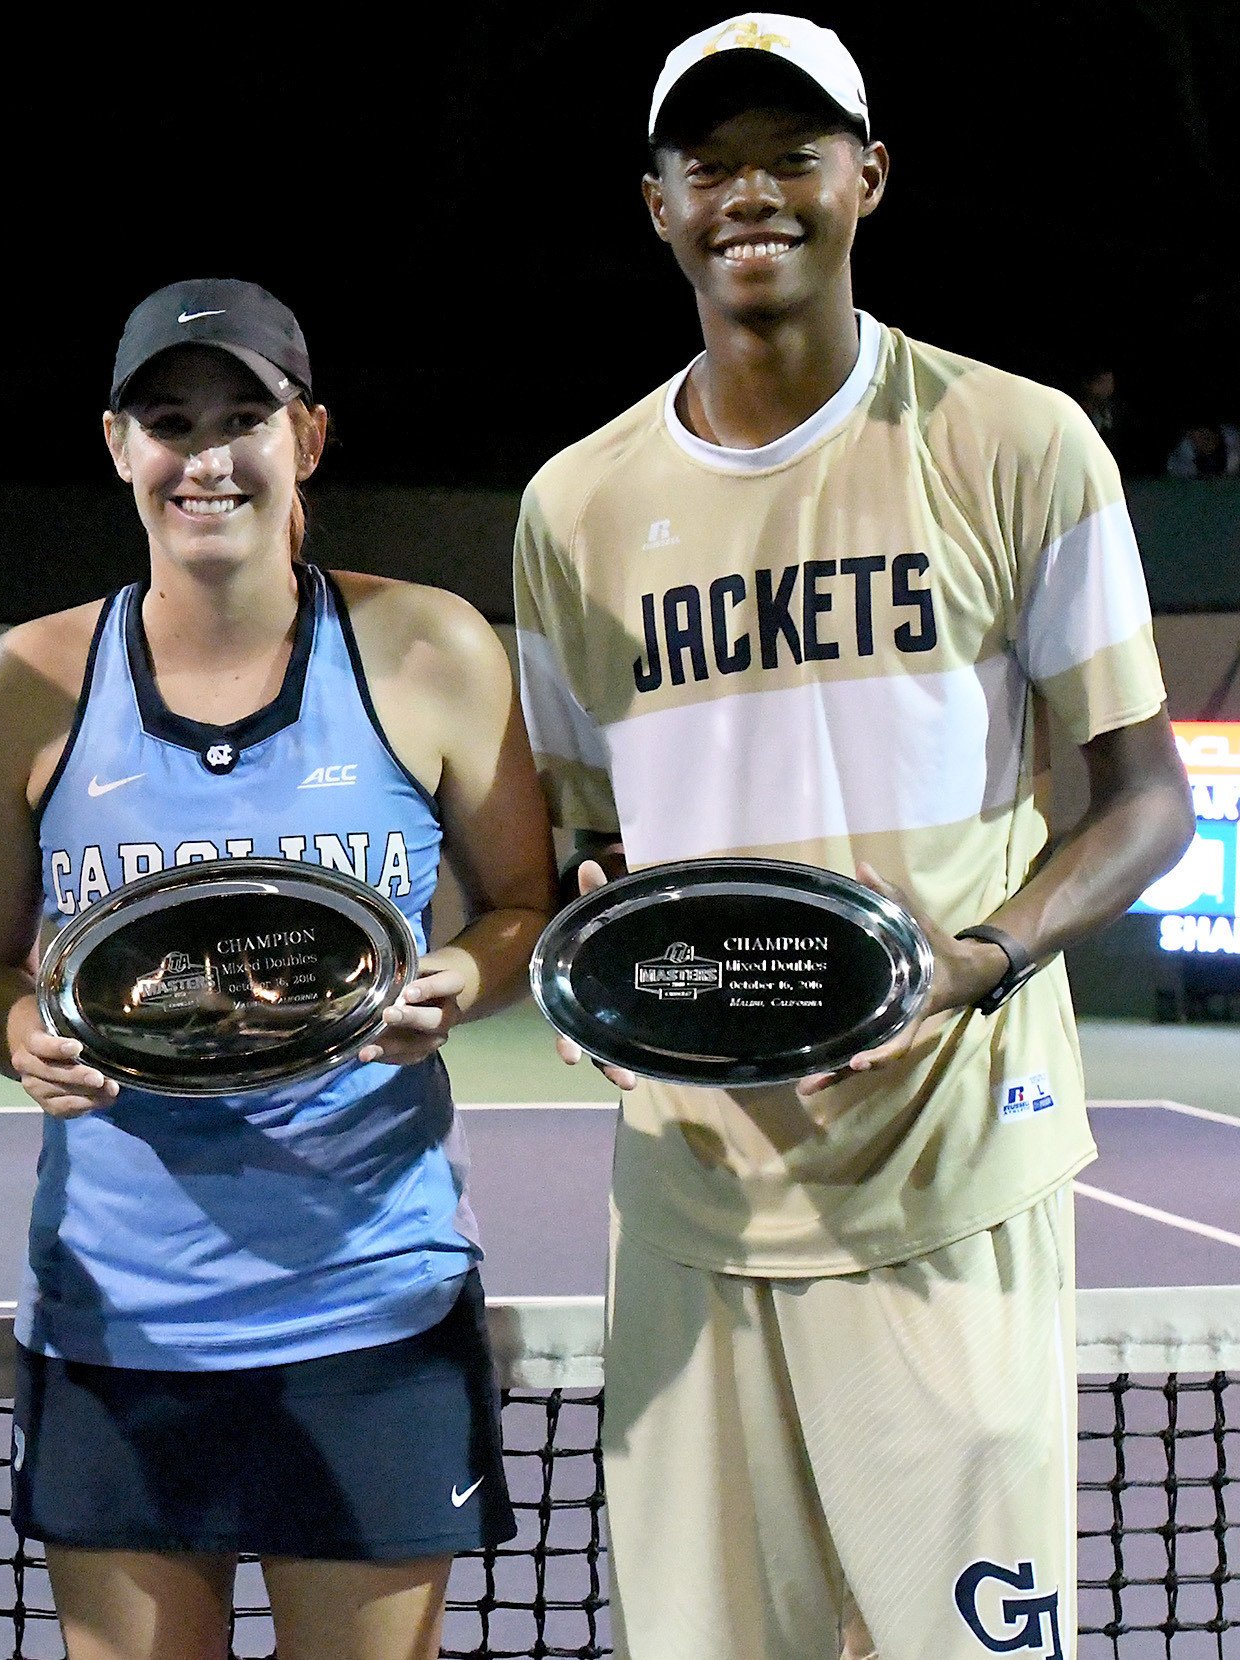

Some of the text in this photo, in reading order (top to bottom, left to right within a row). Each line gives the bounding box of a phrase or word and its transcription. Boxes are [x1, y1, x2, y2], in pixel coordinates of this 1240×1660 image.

[633, 552, 937, 693] JACKETS
[300, 764, 358, 784] ACC
[217, 928, 316, 954] CHAMPION
[723, 937, 828, 951] CHAMPION
[265, 953, 318, 970] Doubles
[725, 960, 827, 971] Mixed Doubles
[293, 974, 316, 985] 2016
[639, 969, 718, 982] MASTERS
[729, 980, 774, 990] October
[799, 980, 823, 990] 2016
